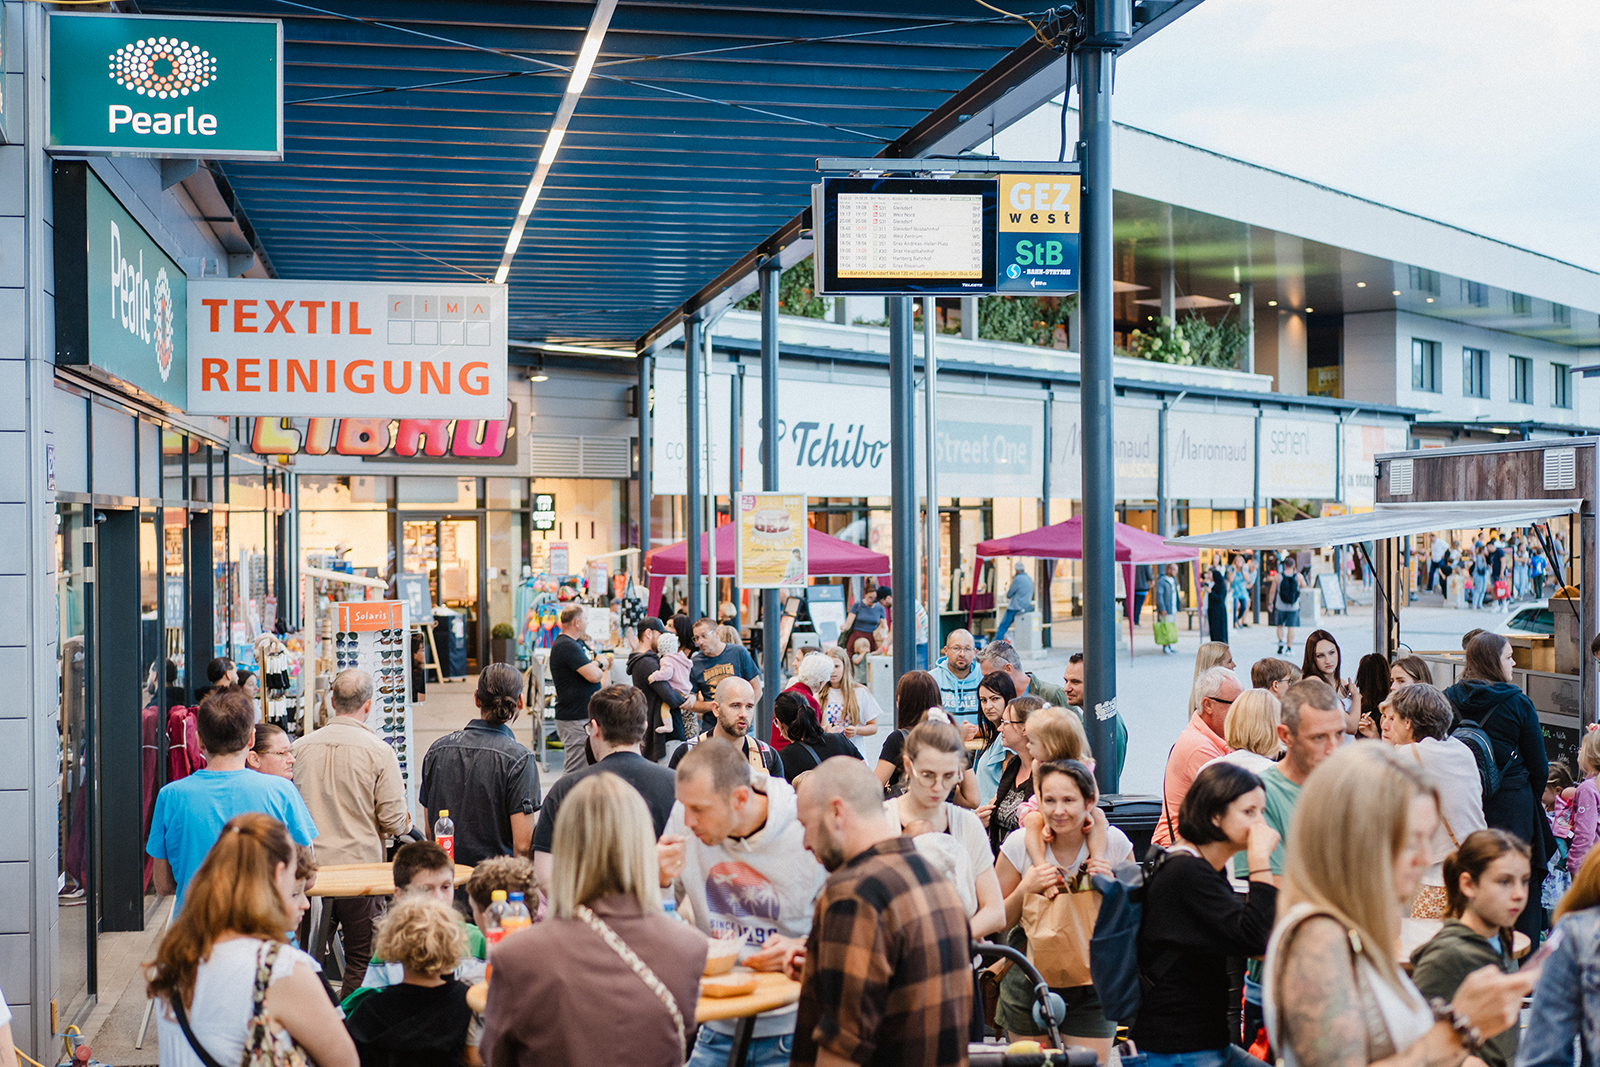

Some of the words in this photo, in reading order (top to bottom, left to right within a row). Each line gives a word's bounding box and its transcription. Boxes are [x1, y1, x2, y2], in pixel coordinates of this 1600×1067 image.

[108, 104, 218, 135] Pearle
[1009, 182, 1071, 211] GEZ
[1009, 211, 1070, 224] west
[1015, 239, 1064, 266] StB
[109, 220, 152, 346] Pearle
[201, 298, 372, 336] TEXTIL
[201, 357, 490, 396] REINIGUNG
[792, 421, 891, 468] Tchibo
[992, 434, 1028, 466] One
[1173, 428, 1248, 467] Marionnaud
[355, 611, 387, 622] Solaris
